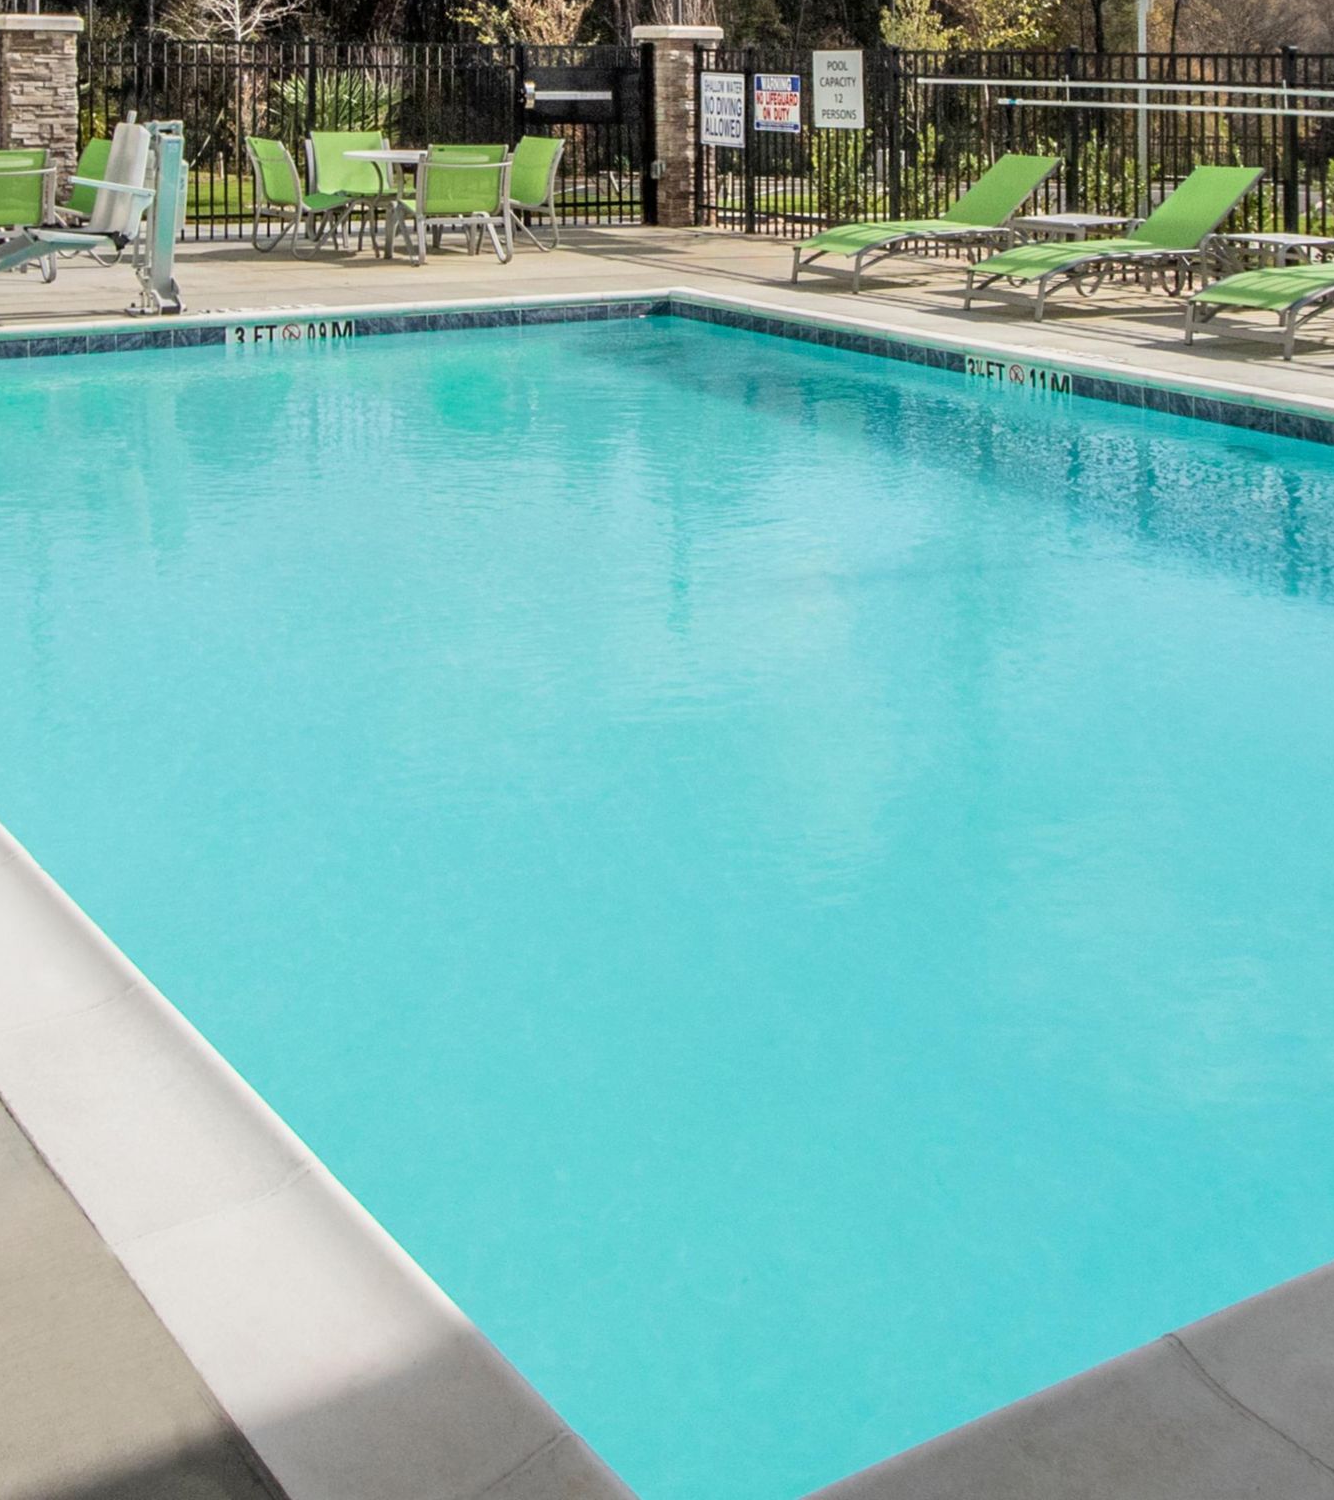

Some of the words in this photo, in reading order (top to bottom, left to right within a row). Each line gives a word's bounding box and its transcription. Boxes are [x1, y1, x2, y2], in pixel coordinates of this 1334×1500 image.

[827, 60, 849, 71] POOL
[819, 77, 856, 88] CAPACITY
[765, 93, 799, 106] LIFEGUARD
[834, 94, 843, 104] 12
[704, 97, 714, 115] NO
[717, 97, 742, 117] DIVING
[774, 108, 790, 121] DUTY
[821, 109, 857, 120] PERSONS
[705, 118, 741, 138] ALLOWED
